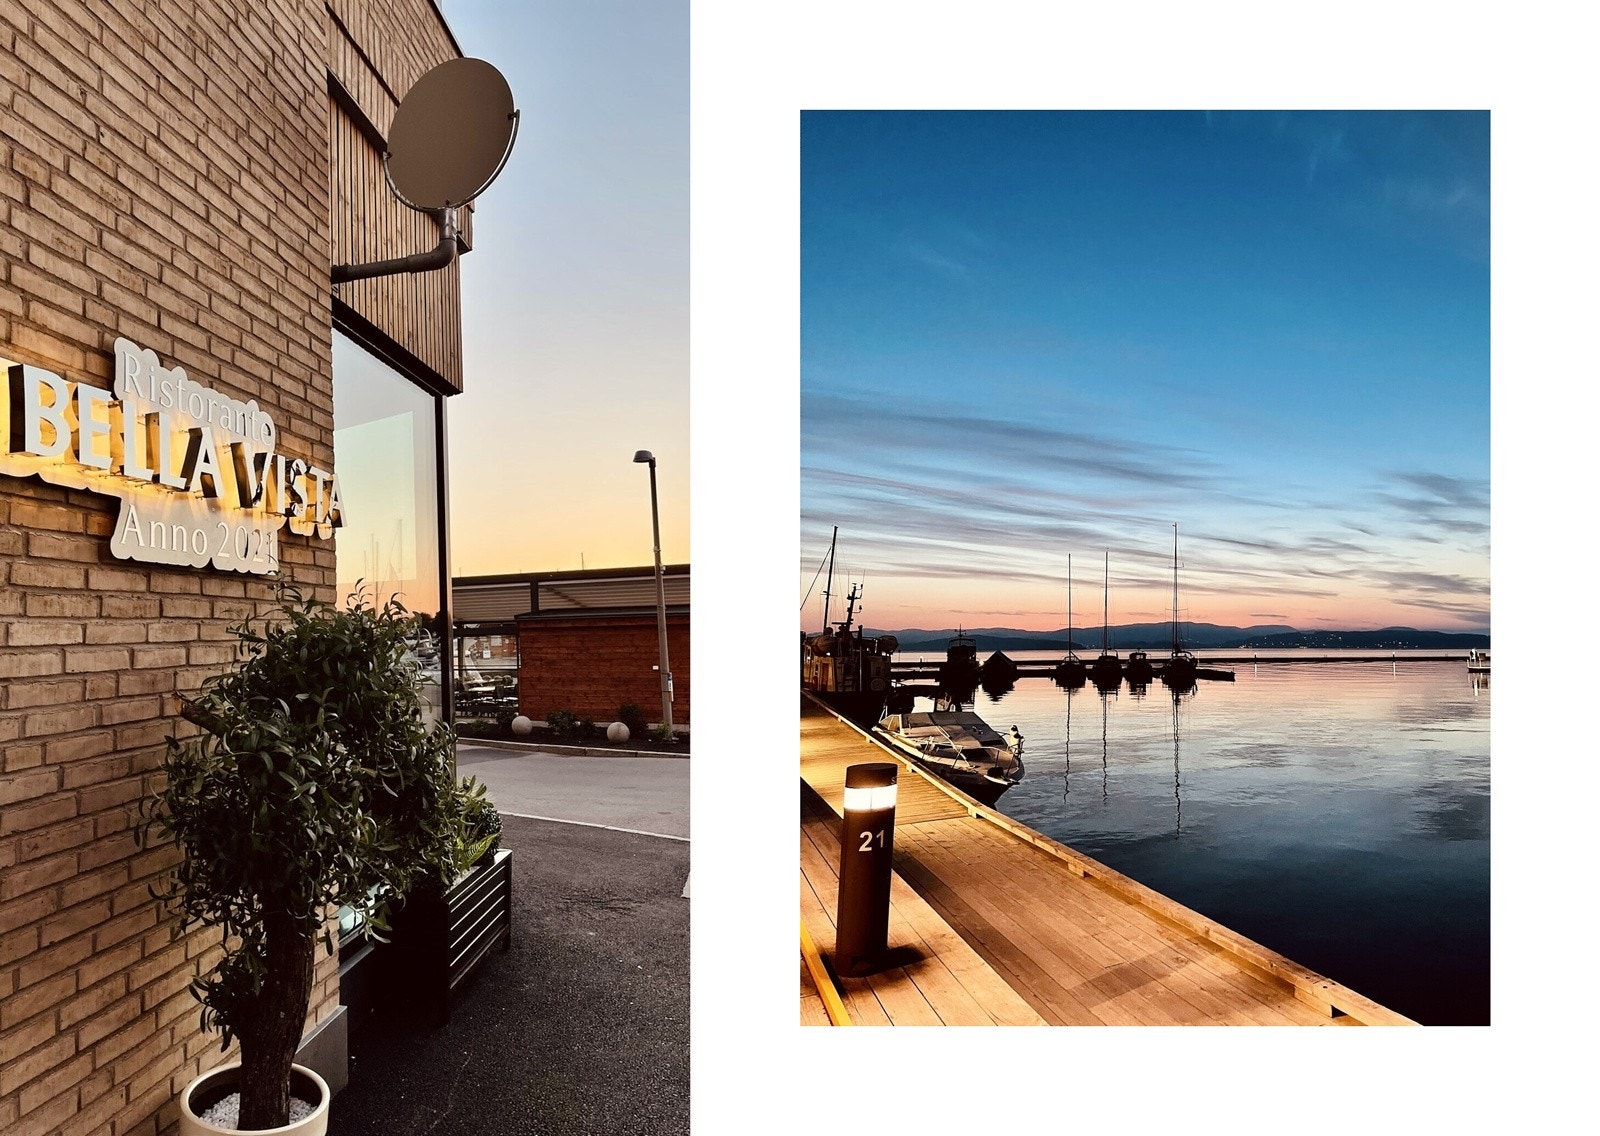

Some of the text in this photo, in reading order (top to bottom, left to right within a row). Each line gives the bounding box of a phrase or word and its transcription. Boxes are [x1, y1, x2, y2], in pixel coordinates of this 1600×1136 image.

[122, 351, 272, 446] Ristorante
[22, 363, 348, 528] BELLA VISTA
[120, 504, 275, 564] Anno 2021
[858, 830, 885, 852] 21
